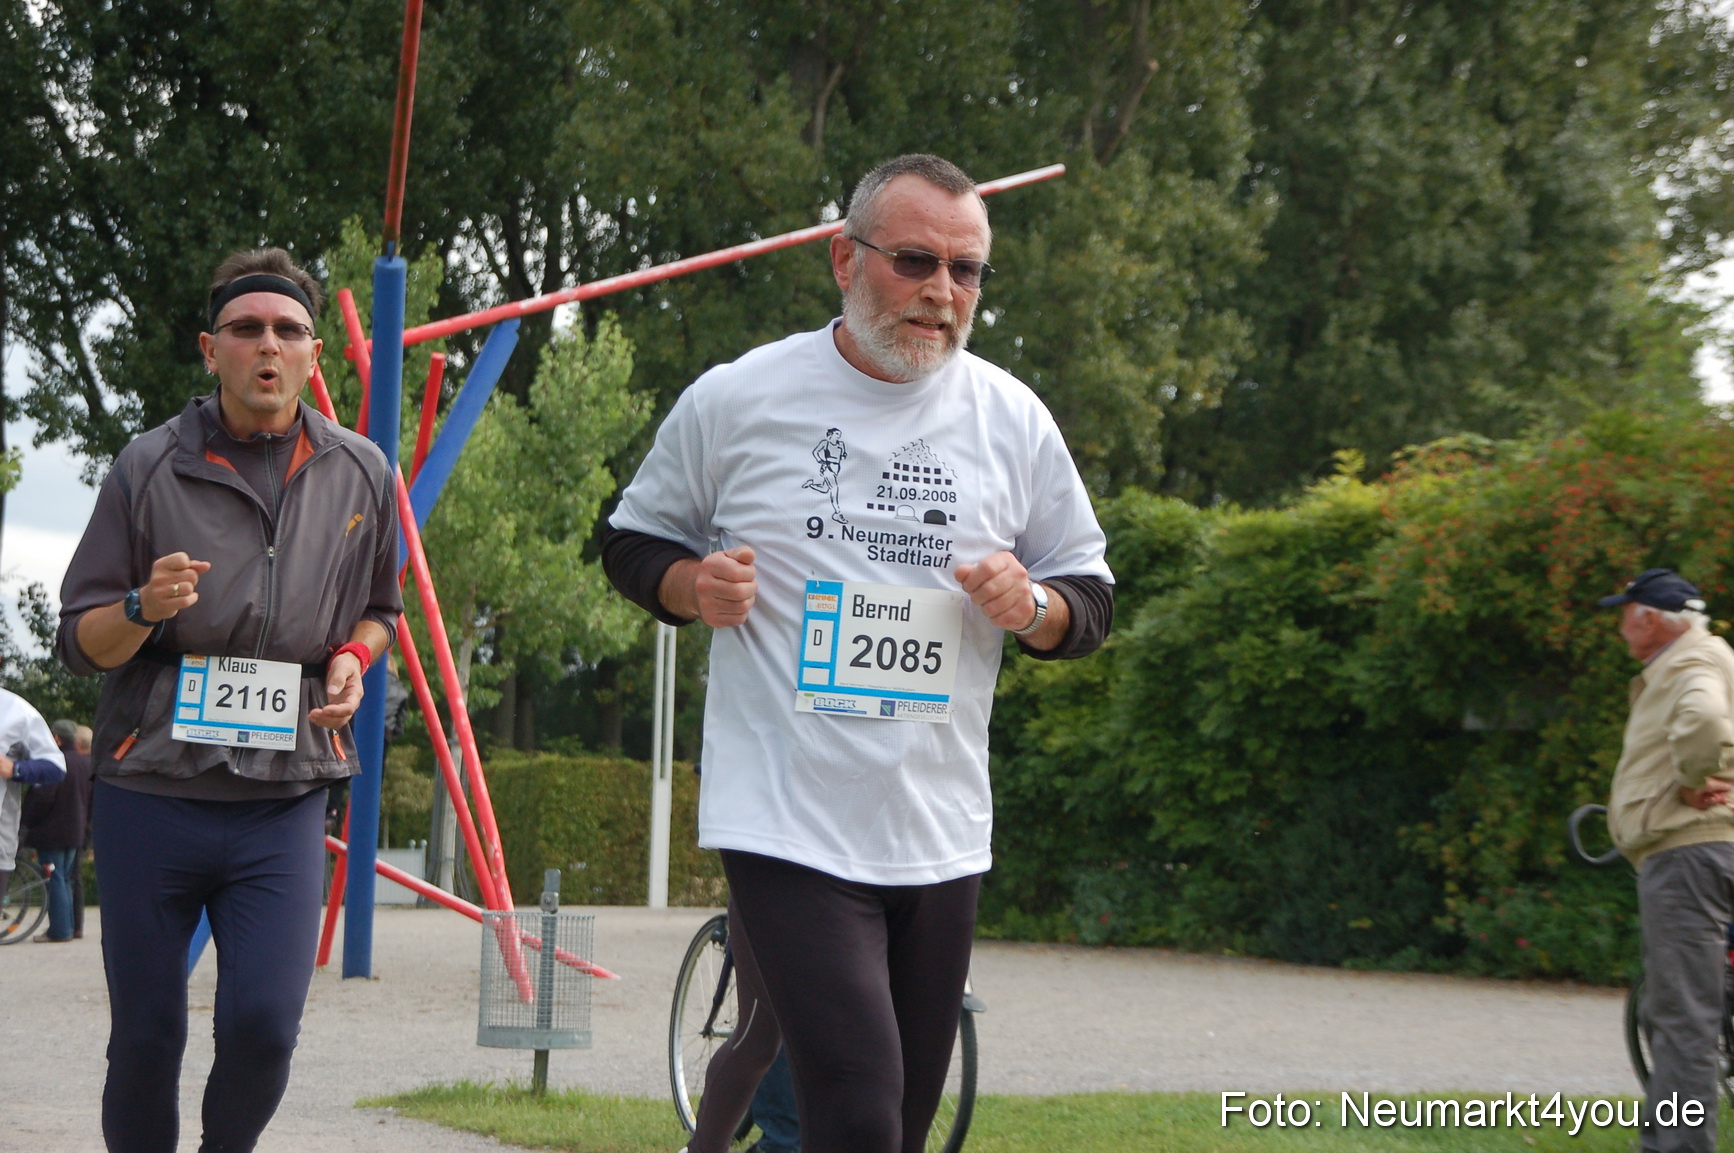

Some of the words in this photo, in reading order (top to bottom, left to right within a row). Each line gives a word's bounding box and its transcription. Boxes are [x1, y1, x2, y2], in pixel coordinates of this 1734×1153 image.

[876, 485, 957, 503] 21.09.2008
[806, 516, 834, 539] 9.
[841, 524, 953, 551] Neumarkter
[867, 545, 952, 569] Stadtlauf
[852, 594, 912, 622] Bernd
[813, 629, 823, 646] D
[849, 634, 943, 675] 2085
[218, 656, 258, 674] Klaus
[188, 679, 196, 692] D
[215, 683, 287, 713] 2116
[897, 700, 948, 715] PFLEIDERER
[251, 731, 294, 742] PFLEIDERER
